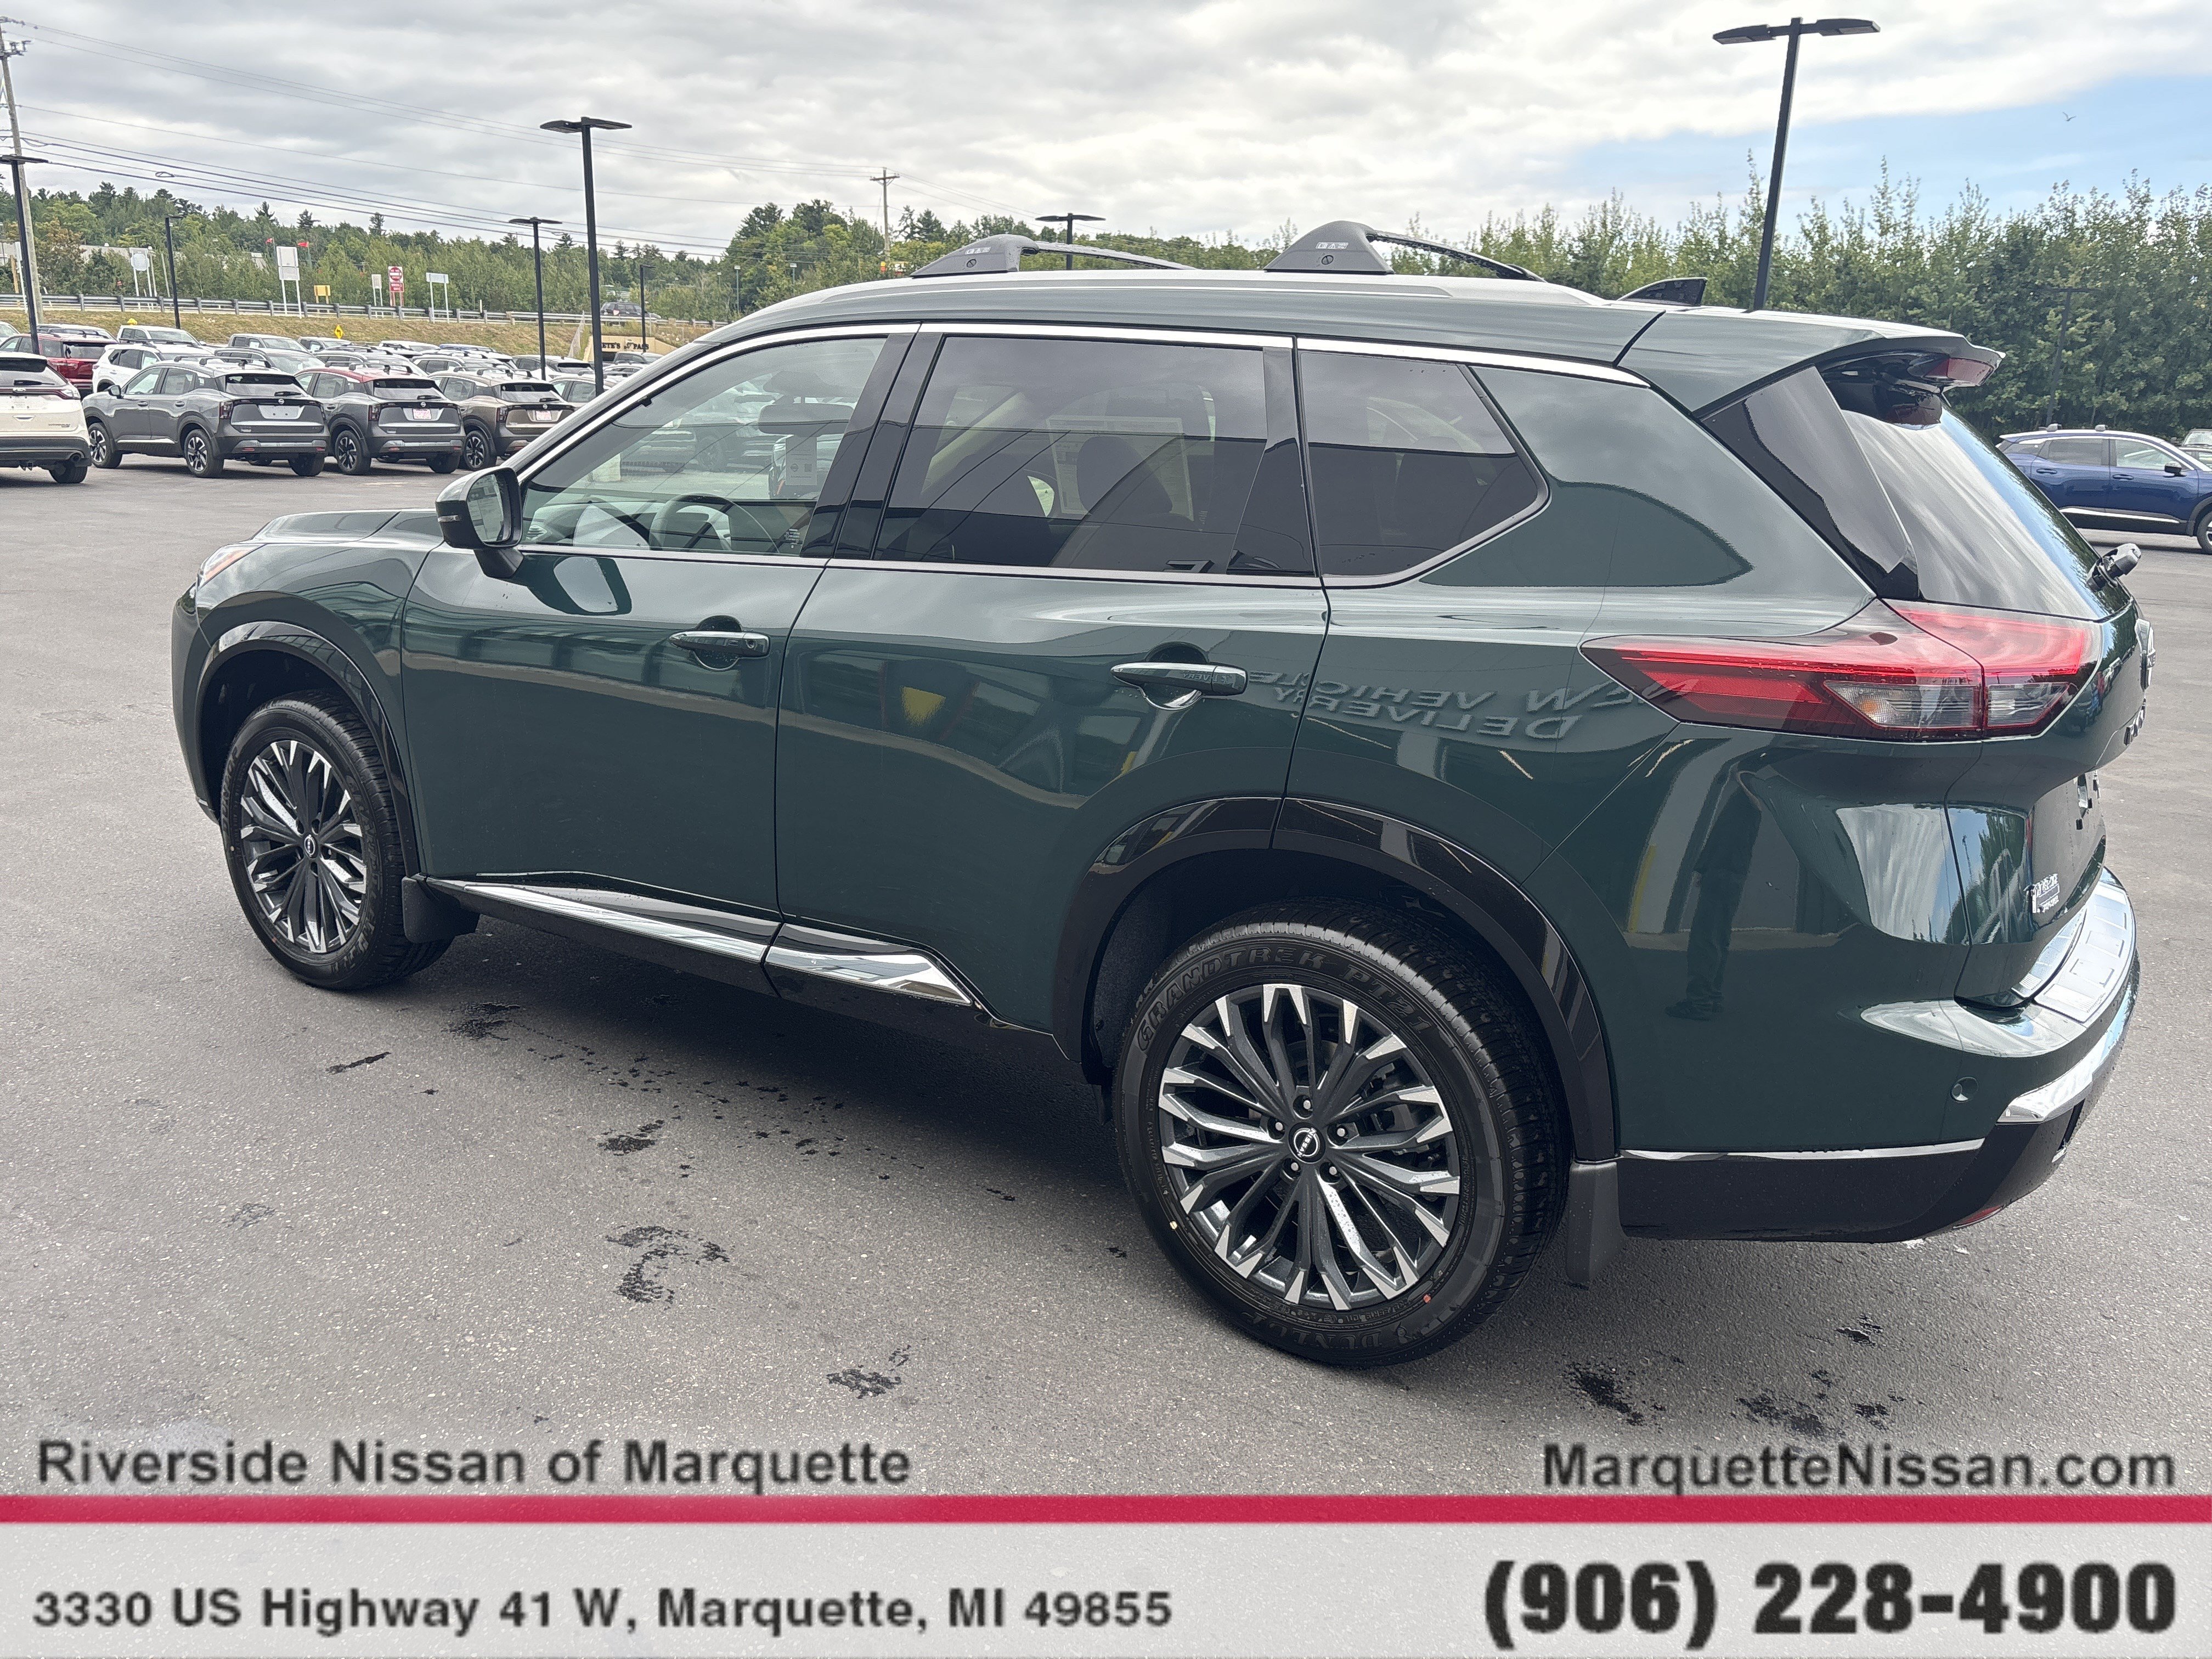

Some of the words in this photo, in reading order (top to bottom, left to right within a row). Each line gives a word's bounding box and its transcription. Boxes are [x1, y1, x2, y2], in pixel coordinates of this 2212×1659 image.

[1137, 946, 1328, 1052] GRANDTREK
[1339, 964, 1432, 1034] PT21
[1297, 1127, 1317, 1158] NISSAN
